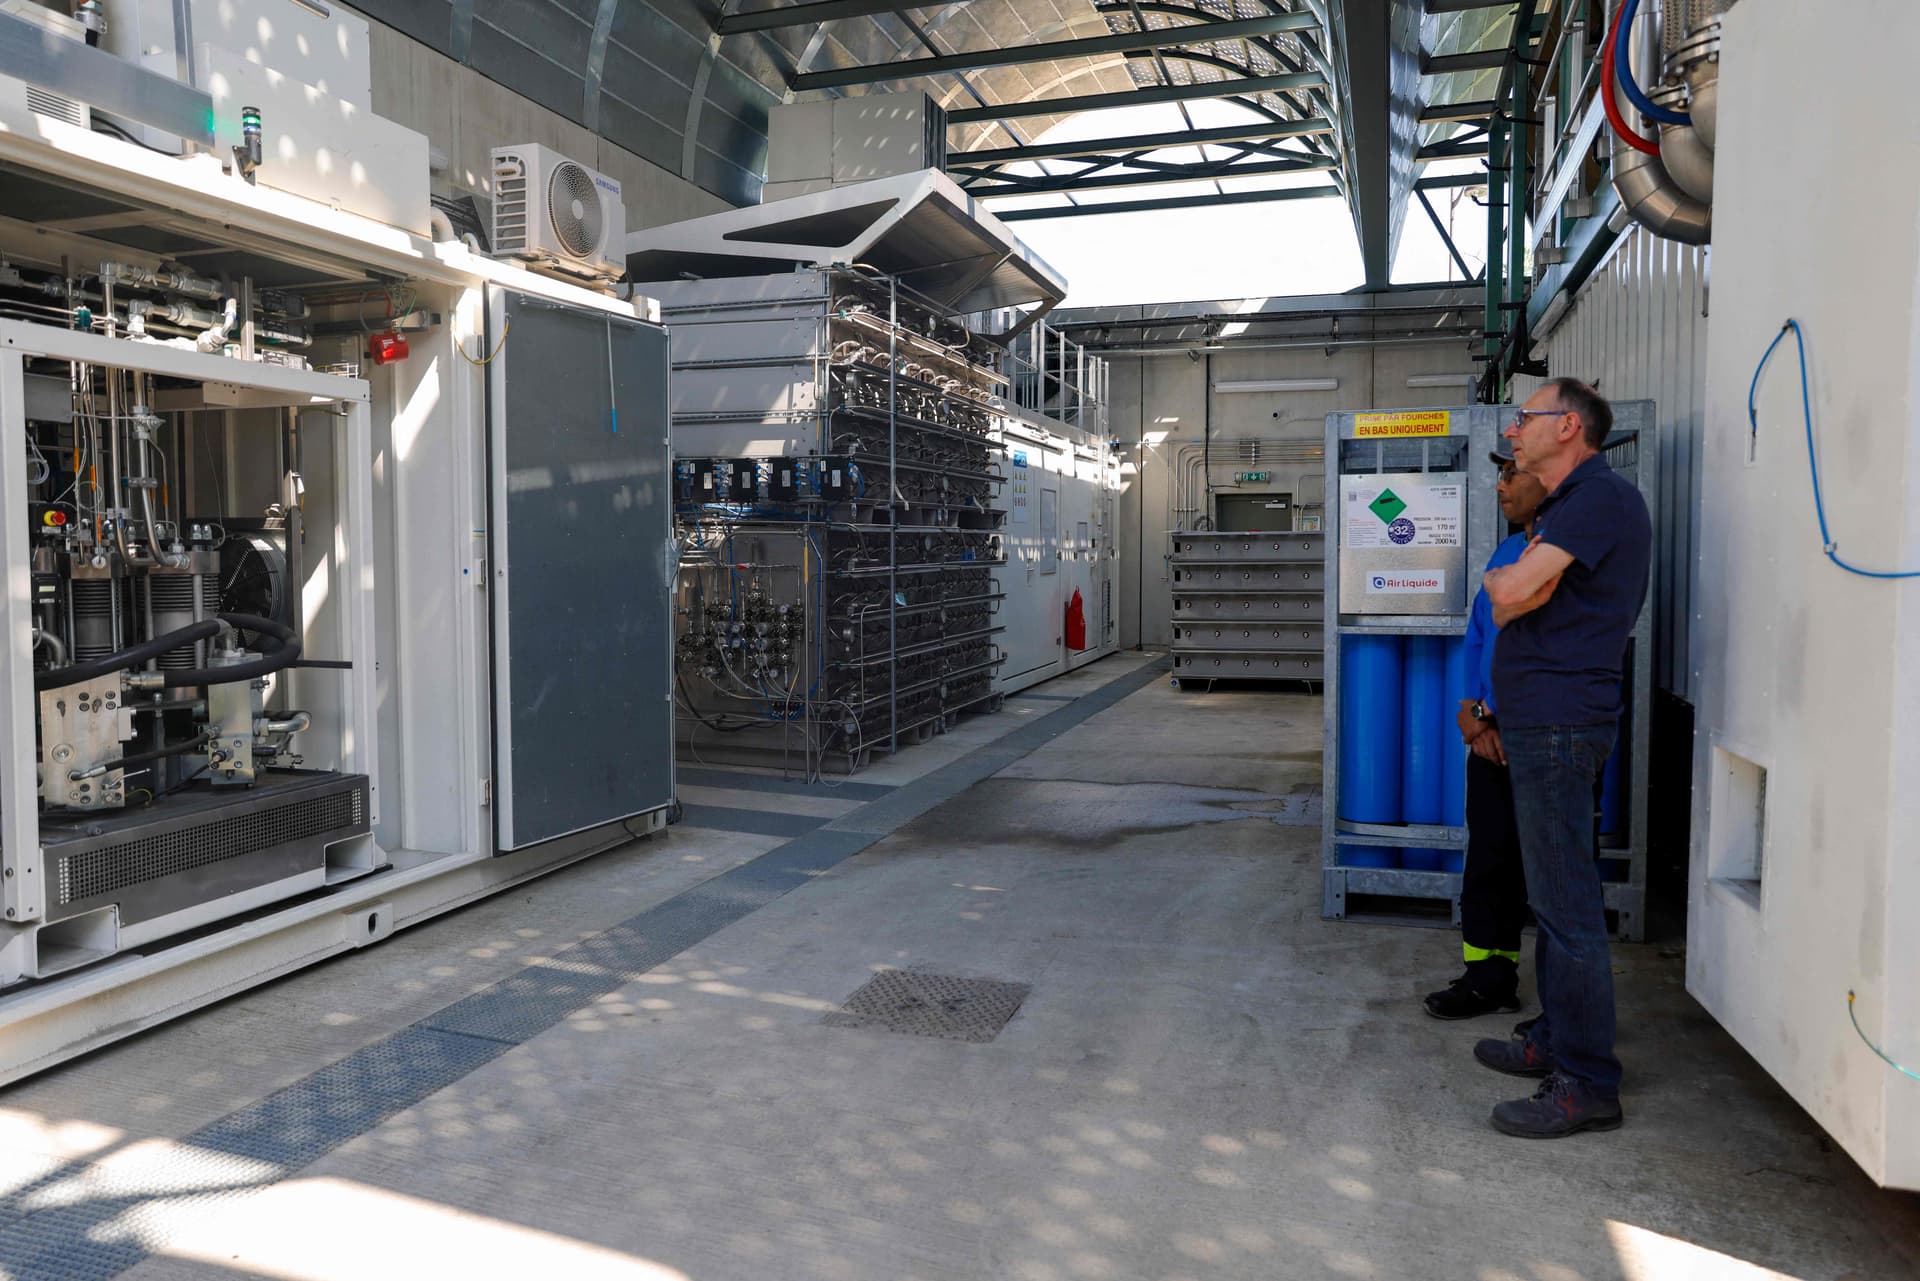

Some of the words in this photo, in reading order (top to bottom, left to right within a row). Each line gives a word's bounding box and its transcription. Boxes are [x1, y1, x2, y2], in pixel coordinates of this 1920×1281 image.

[595, 178, 619, 194] SAMSUNG
[1401, 413, 1444, 421] FOURCHES
[1360, 426, 1370, 435] EN
[1372, 426, 1388, 435] BAS
[1391, 424, 1444, 434] UNIQUEMENT
[1394, 525, 1408, 535] 32
[1387, 579, 1400, 587] Air
[1402, 579, 1438, 588] Liquide
